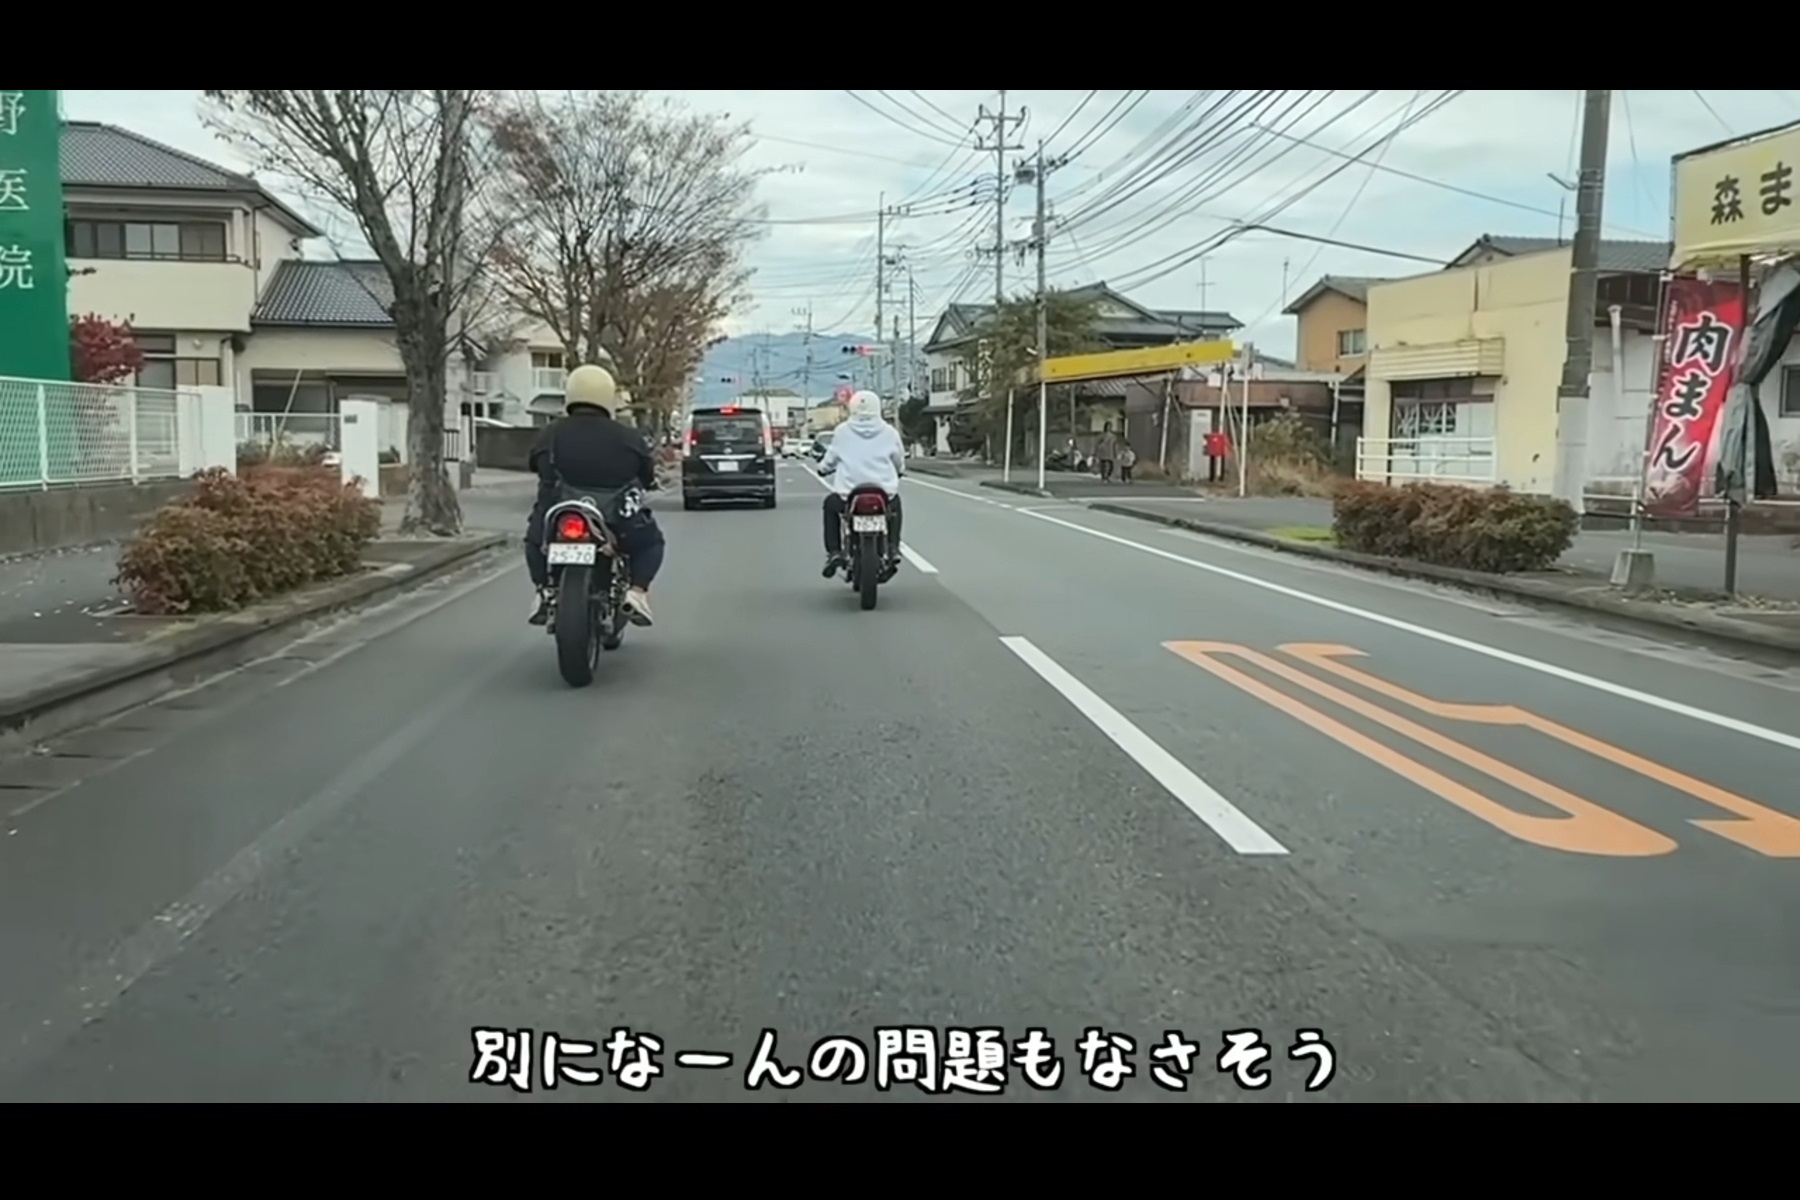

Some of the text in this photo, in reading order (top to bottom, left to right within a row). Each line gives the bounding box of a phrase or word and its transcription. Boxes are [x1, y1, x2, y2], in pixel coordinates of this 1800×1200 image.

[1710, 161, 1793, 225] 森ま
[1651, 311, 1733, 474] 肉まん
